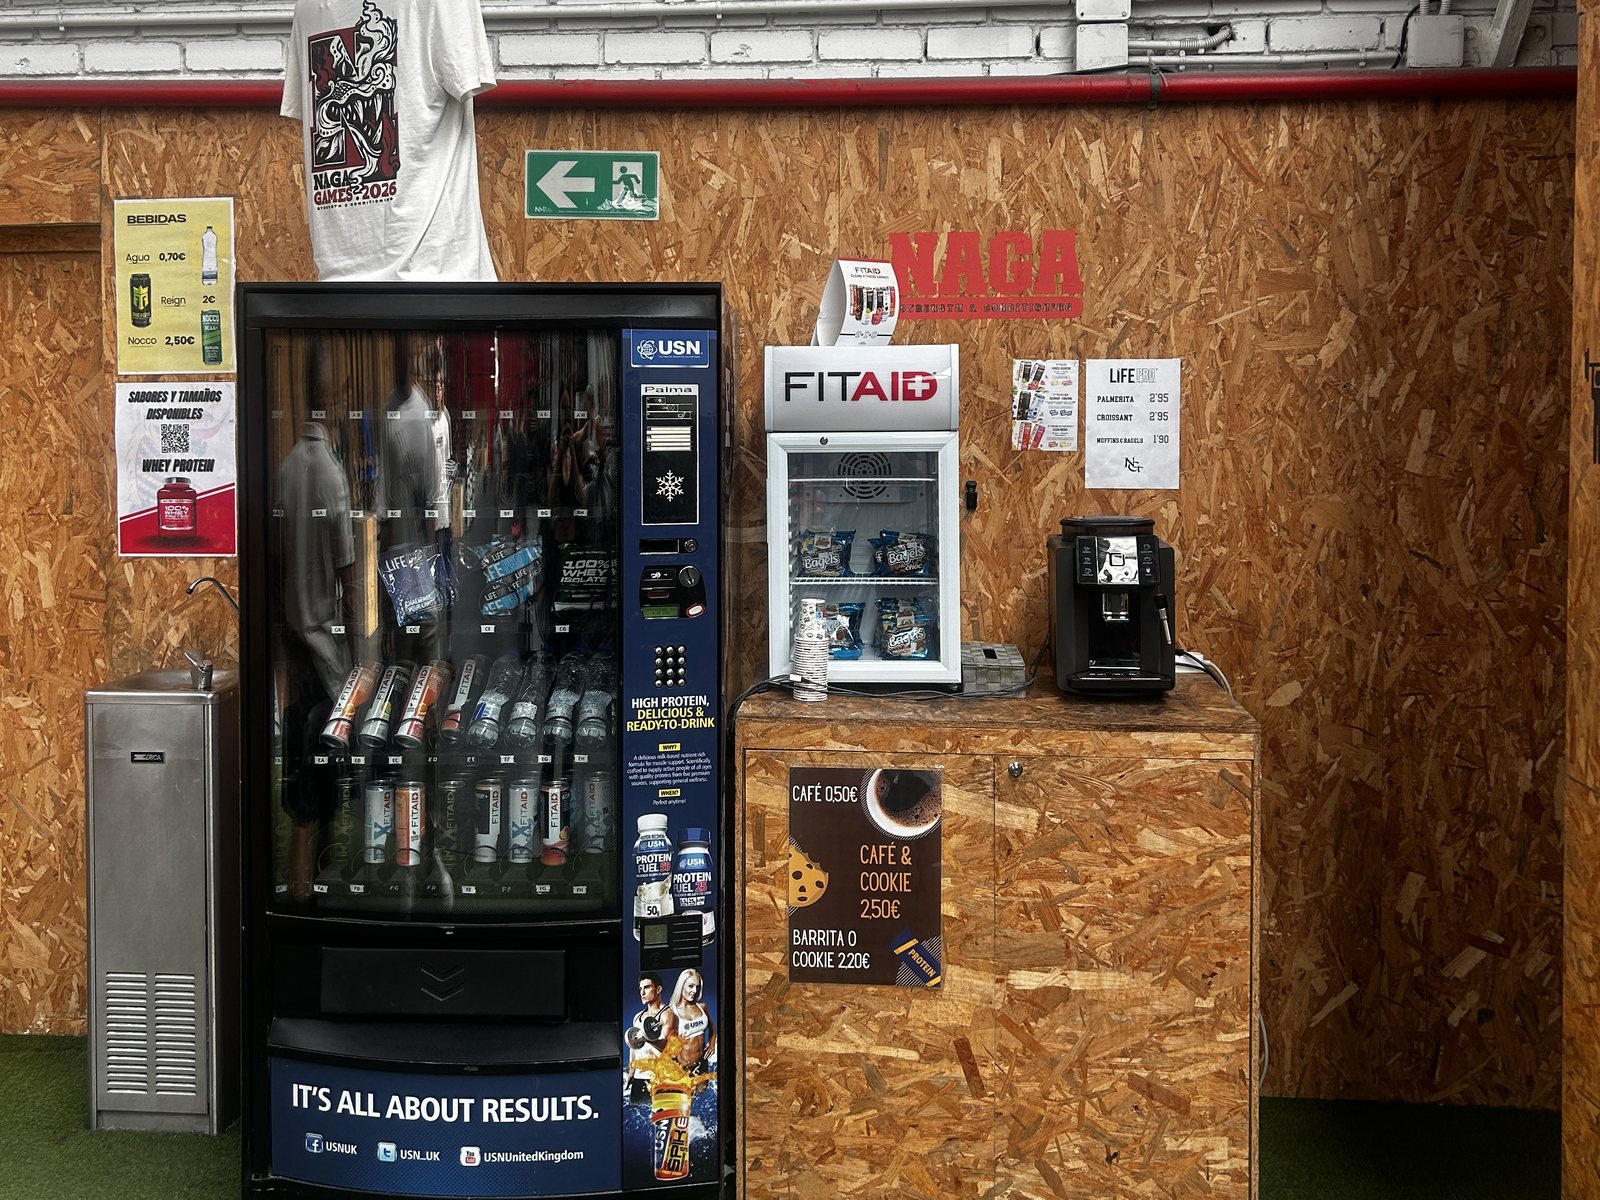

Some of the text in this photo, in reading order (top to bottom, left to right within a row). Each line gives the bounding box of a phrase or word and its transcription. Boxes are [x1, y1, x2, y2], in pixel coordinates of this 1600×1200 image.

[314, 170, 351, 190] NAGA
[314, 182, 397, 205] GAMES 2026
[127, 214, 187, 224] BEBIDAS
[126, 253, 186, 263] Agua 0,70€
[889, 230, 1084, 296] NAGA
[161, 295, 216, 306] Reign 2€
[128, 337, 195, 346] Nocco 2,50€
[659, 340, 700, 355] USN
[1110, 368, 1135, 383] LIFE
[784, 372, 938, 401] FITAID
[128, 388, 222, 403] SABORES Y TAMAÑOS
[1150, 393, 1169, 403] 2'95
[146, 408, 204, 420] DISPONIBLES
[1150, 412, 1169, 421] 2'95
[1153, 435, 1169, 443] 1'90
[142, 459, 215, 472] WHEY PROTEIN
[385, 554, 407, 574] LIFE
[492, 551, 505, 562] LIFE
[804, 552, 840, 570] Bagels
[887, 548, 926, 566] Bagels
[563, 560, 610, 569] 100%
[514, 568, 528, 580] LIFE
[562, 569, 608, 577] WHEY
[484, 591, 497, 601] LIFE
[341, 667, 359, 701] FITAID
[377, 669, 393, 700] FITAID
[412, 666, 427, 701] FITAID
[460, 663, 473, 695] FITAID
[631, 695, 710, 708] HIGH PROTEIN,
[637, 706, 704, 720] DELICIOUS &
[627, 717, 715, 731] READY-TO-DRINK
[792, 783, 858, 804] CAFÉ 0,50€
[636, 853, 672, 864] PROTEIN
[860, 842, 912, 865] CAFÉ &
[638, 863, 659, 874] FUEL
[687, 858, 705, 866] USN
[673, 872, 712, 883] PROTEIN
[860, 872, 912, 893] COOKIE
[674, 881, 707, 893] FUEL 25
[860, 899, 901, 920] 2,50€
[793, 929, 845, 947] BARRITA
[792, 951, 870, 970] COOKIE 2,20€
[908, 949, 936, 977] PROTEIN
[291, 1082, 600, 1123] IT'S ALL ABOUT RESULTS.
[655, 1120, 669, 1150] USN
[326, 1141, 357, 1155] USNUK
[668, 1117, 688, 1172] SPIKE
[400, 1150, 440, 1161] USN_UK
[483, 1149, 584, 1165] USNUnitedKingdom
